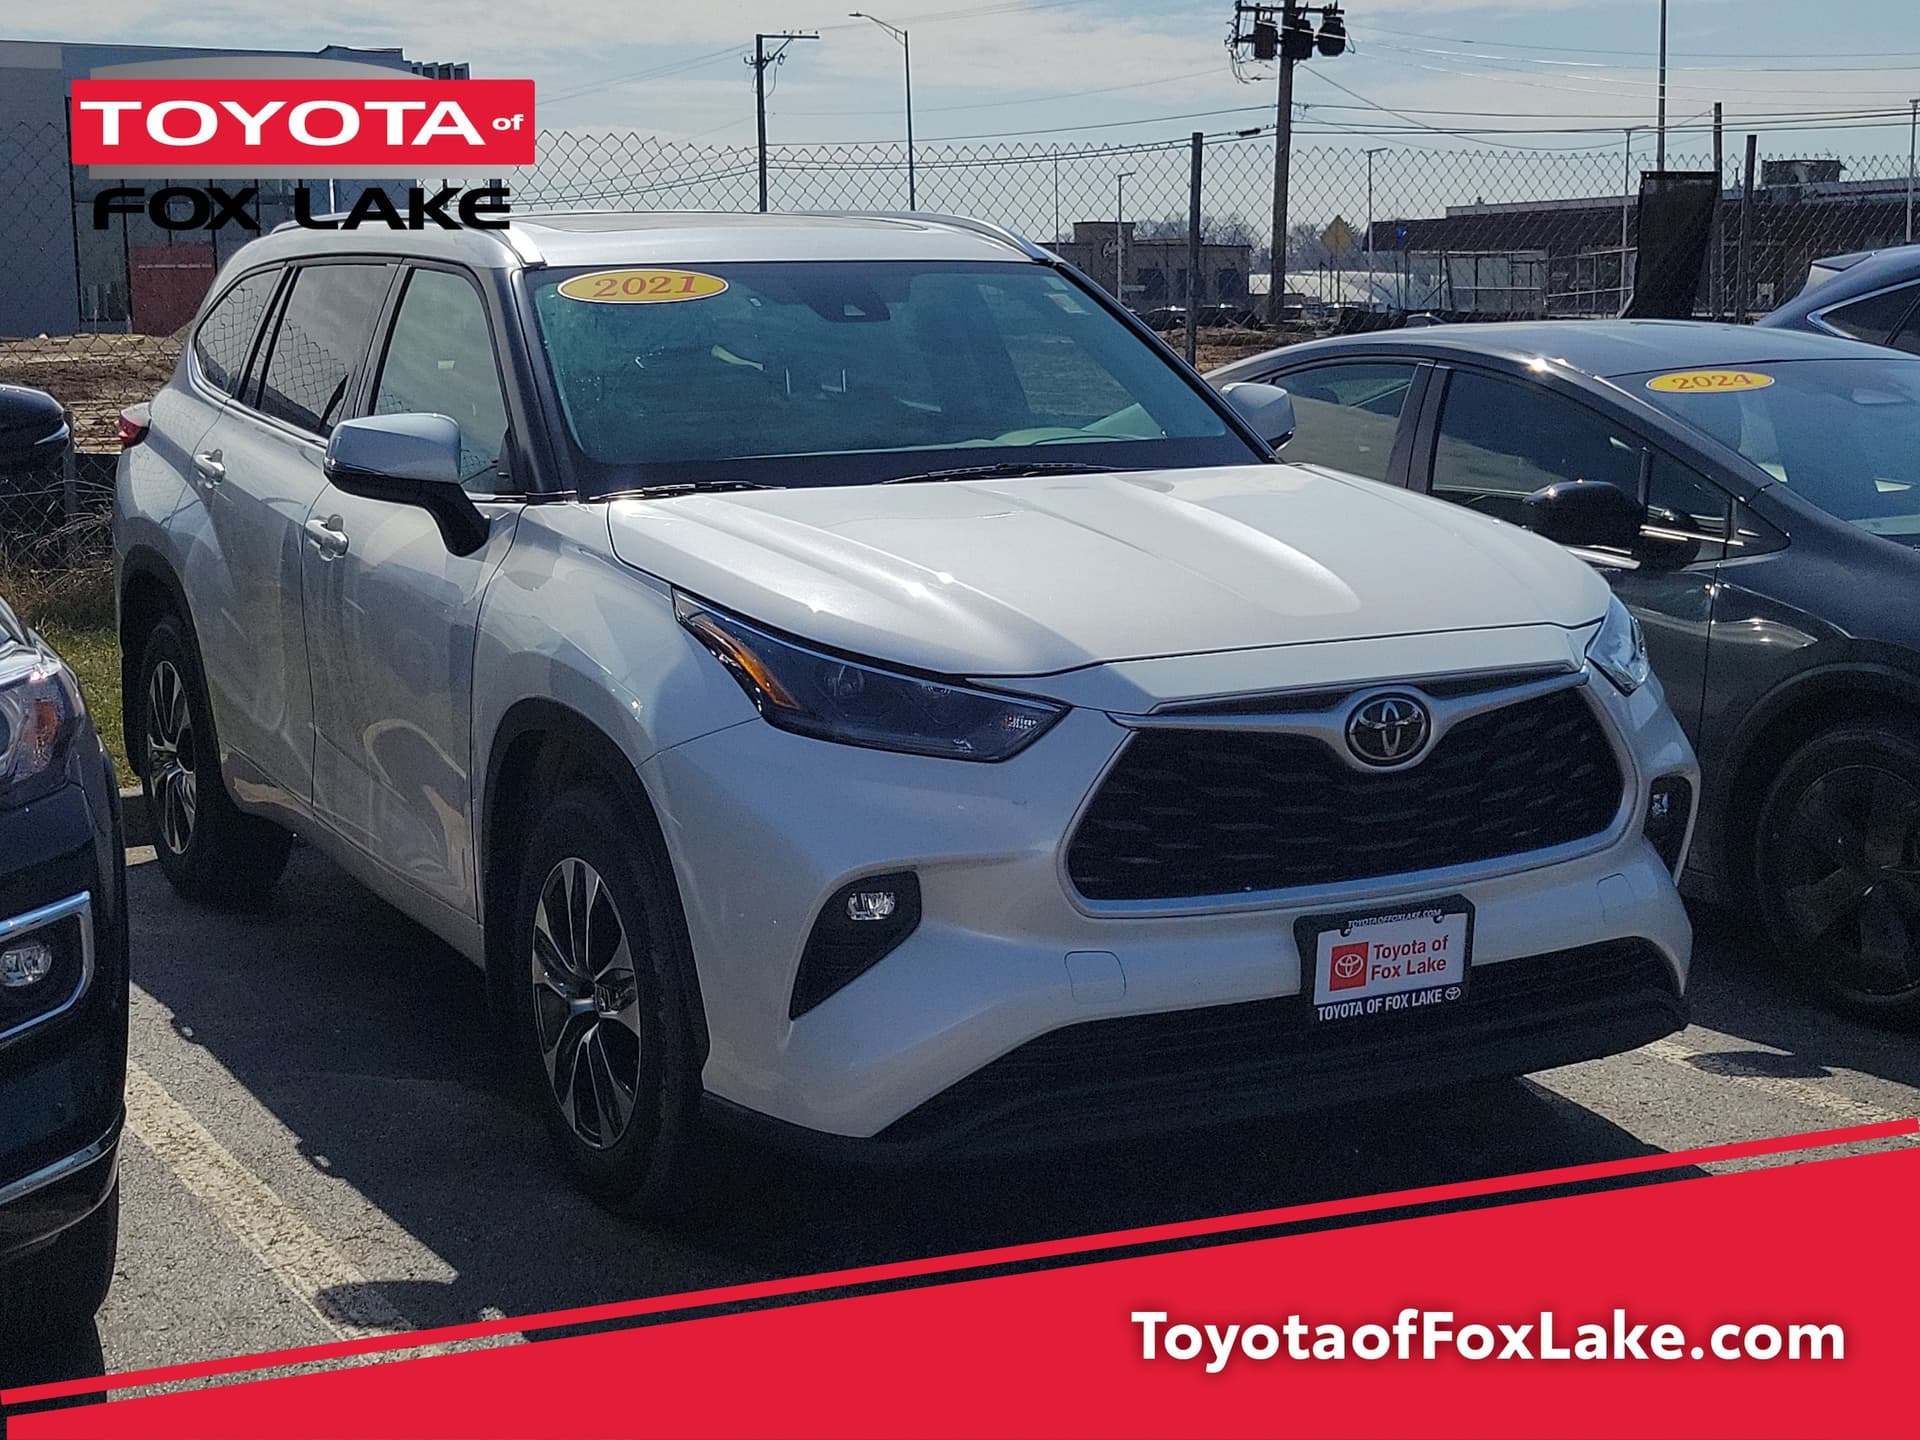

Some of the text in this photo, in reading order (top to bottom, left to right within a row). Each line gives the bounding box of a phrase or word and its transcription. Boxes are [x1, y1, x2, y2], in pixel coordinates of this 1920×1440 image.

[593, 275, 697, 297] 2021
[1672, 374, 1752, 390] 2024
[1373, 935, 1449, 961] Toyota of
[1371, 956, 1447, 980] Fox Lake
[1317, 988, 1443, 1021] TOYOTA OF FOX LAKE
